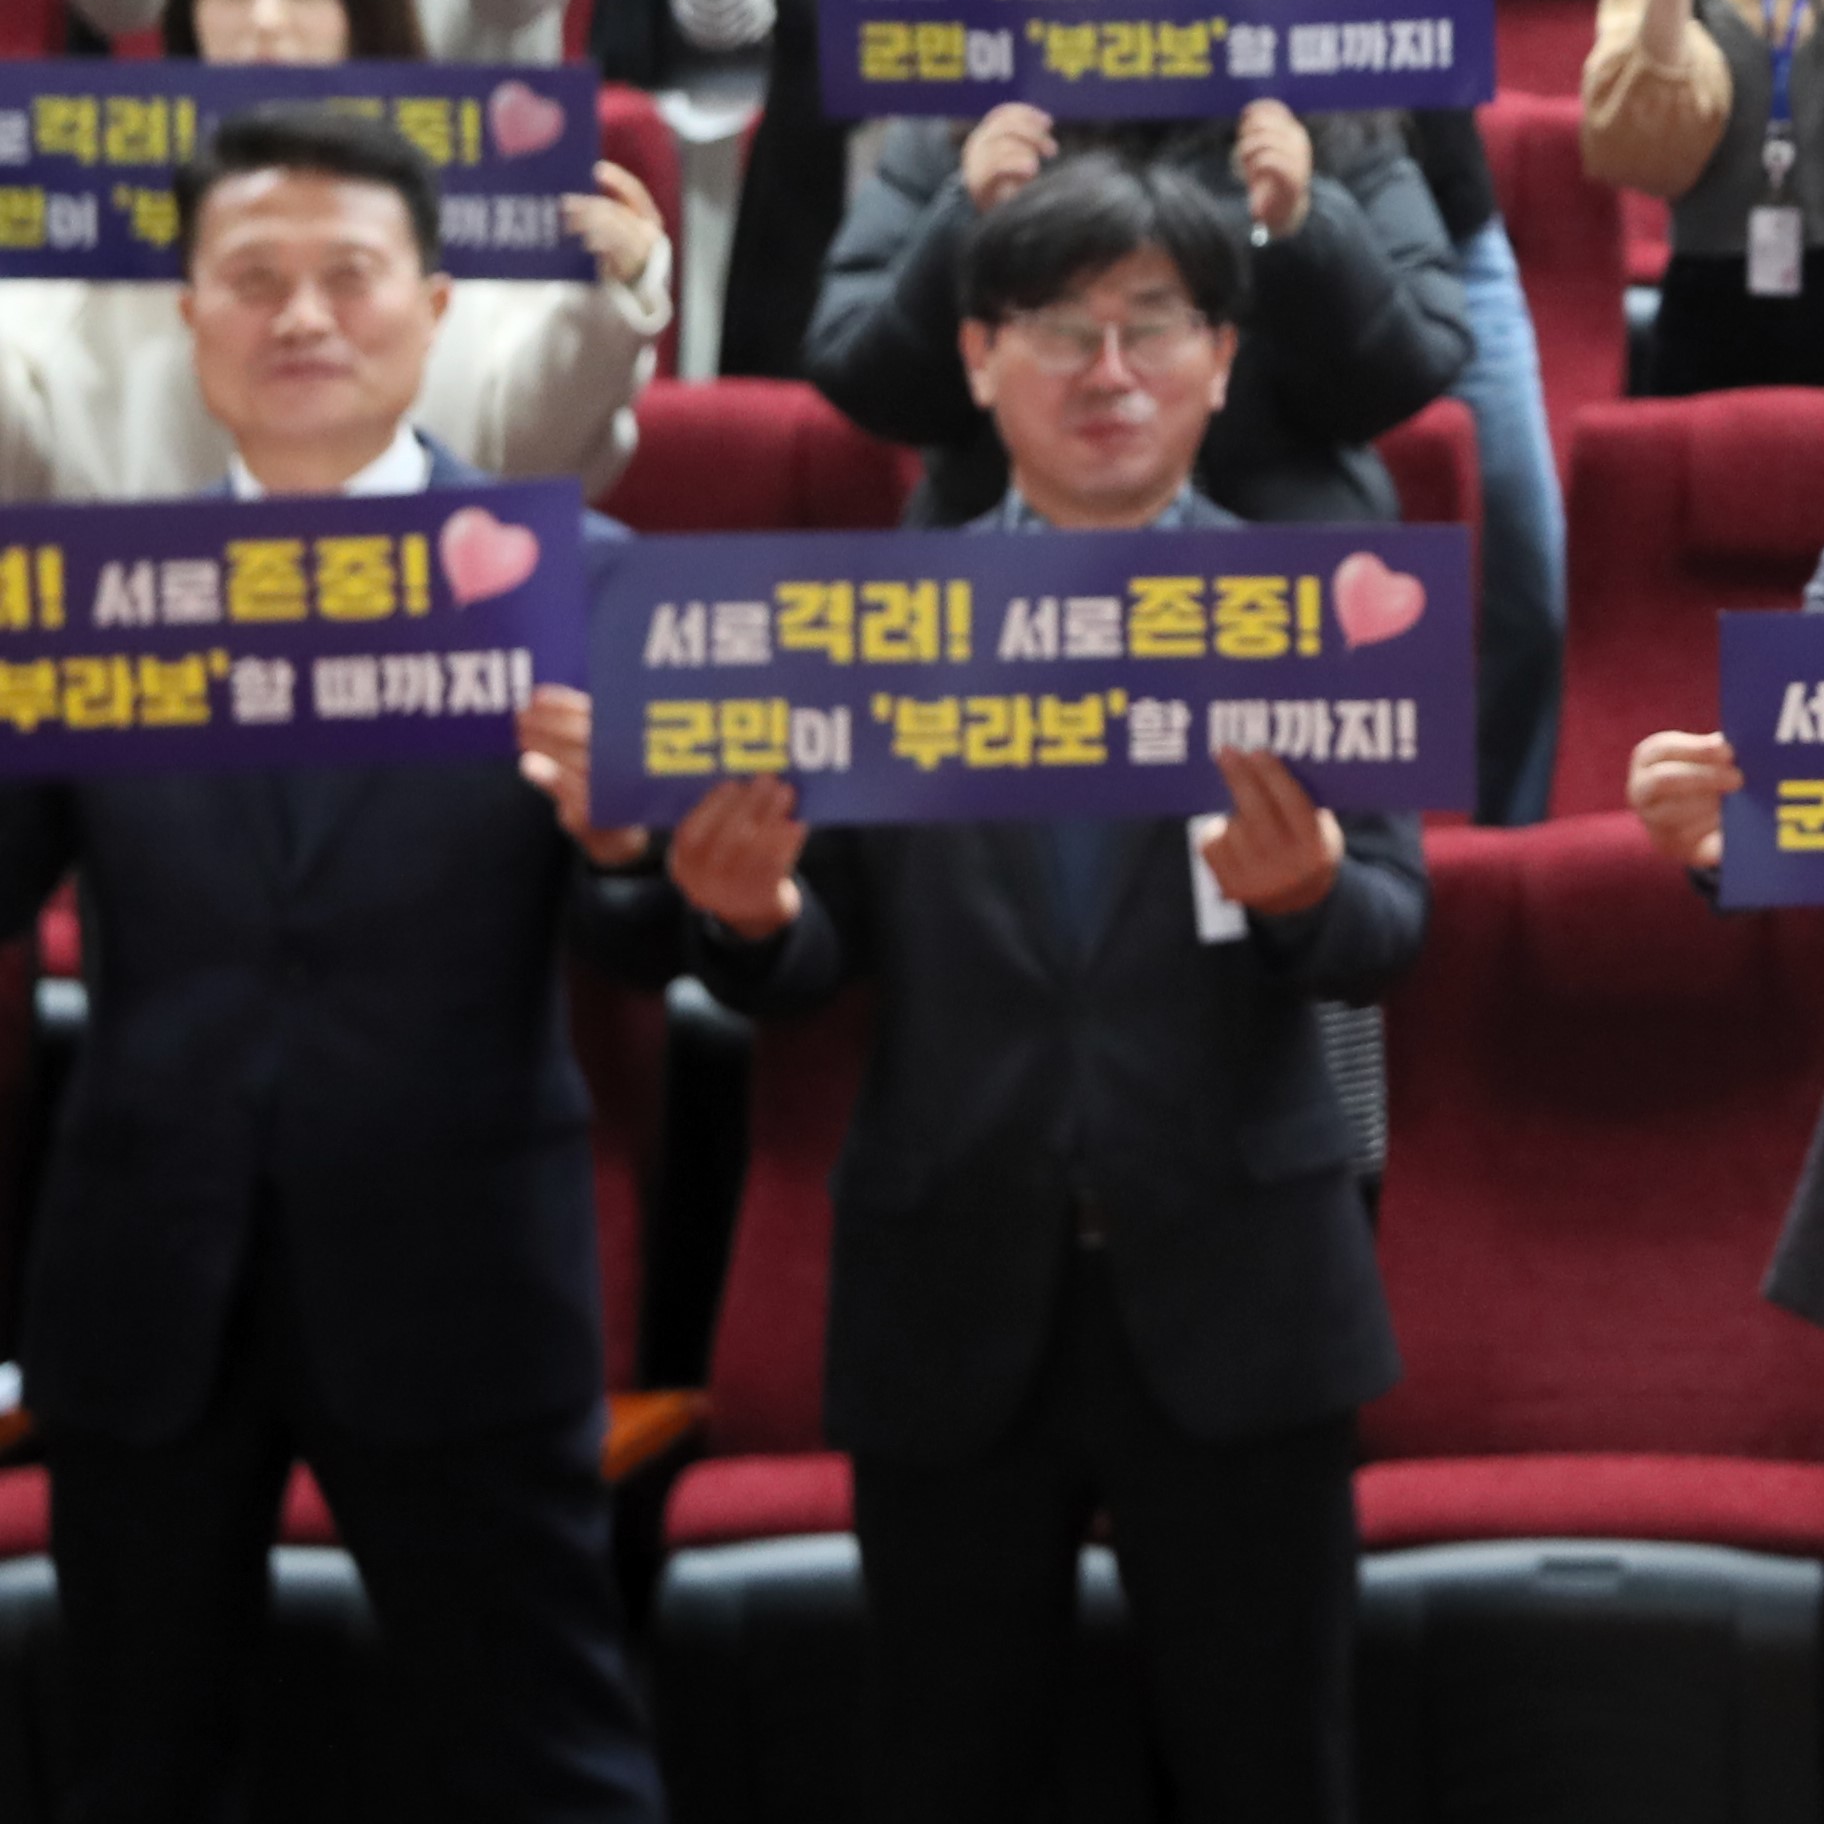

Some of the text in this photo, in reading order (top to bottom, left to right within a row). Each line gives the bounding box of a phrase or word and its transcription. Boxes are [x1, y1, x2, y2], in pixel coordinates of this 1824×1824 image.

[859, 17, 1454, 80] 군민이 '부라보'할 때까지!
[94, 532, 432, 629] 서로존중!
[644, 576, 1319, 664] 서로격려! 서로존중!
[0, 647, 533, 734] 부라보'할 때까지!
[645, 690, 1415, 773] 군민이 '부라보'할 때까지!
